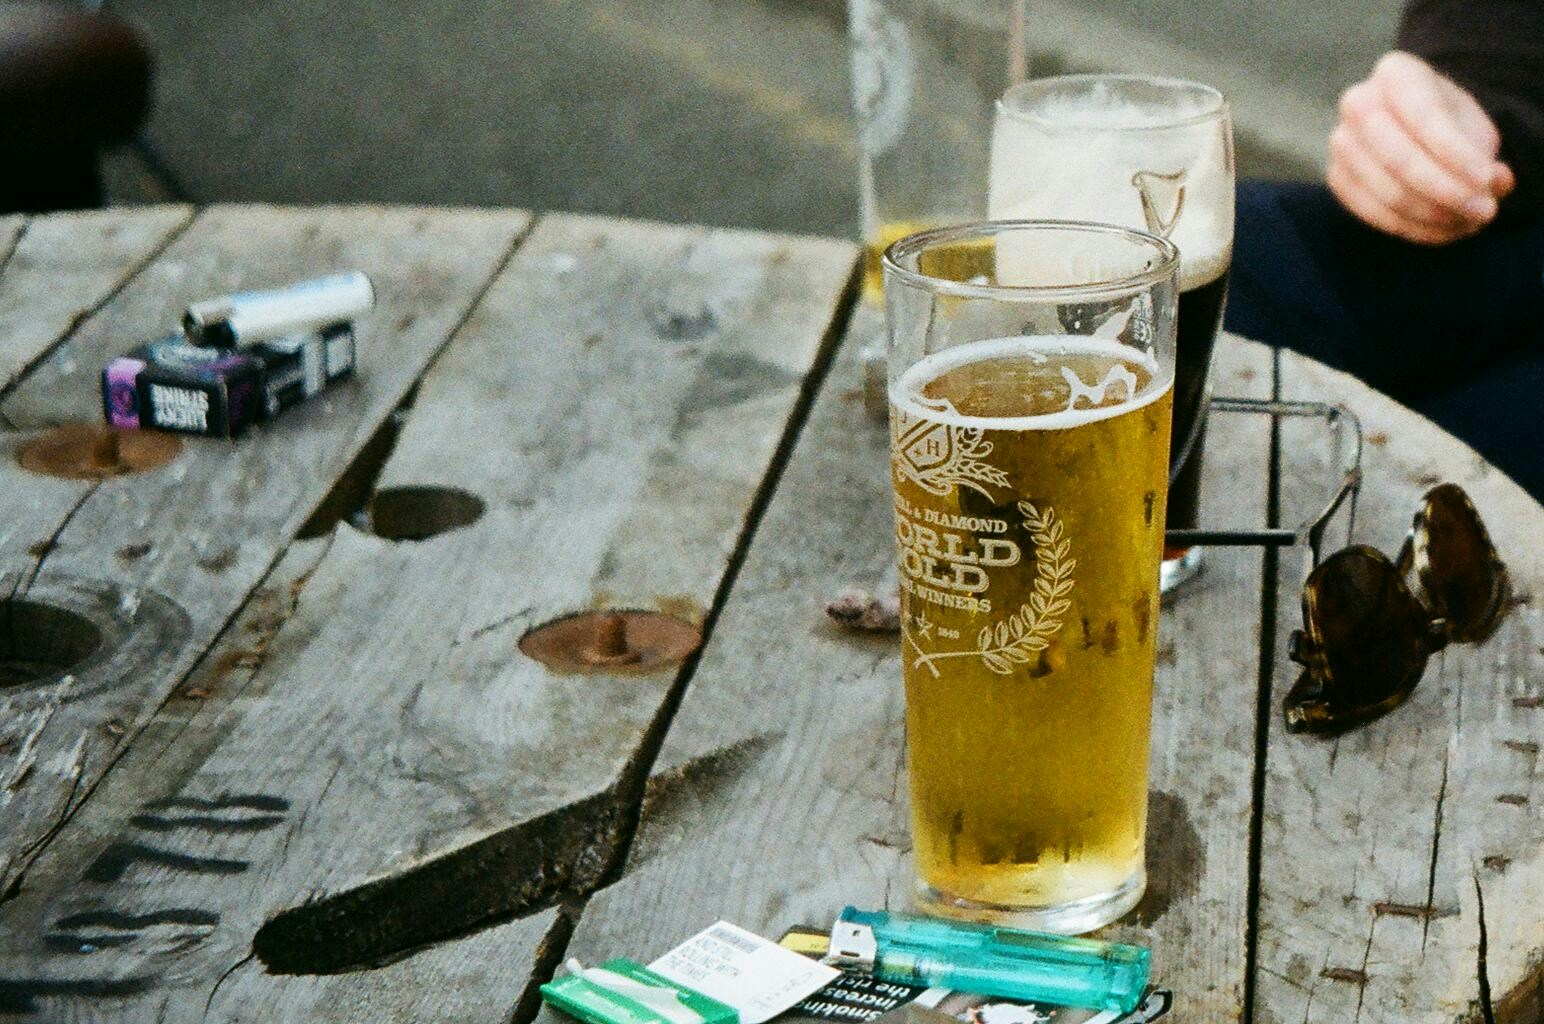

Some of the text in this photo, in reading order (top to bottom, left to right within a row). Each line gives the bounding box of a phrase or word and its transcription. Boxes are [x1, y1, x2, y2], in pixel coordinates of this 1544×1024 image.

[924, 509, 1008, 534] DIAMOND
[896, 515, 1021, 568] ORLD
[900, 545, 990, 594] OLD
[916, 584, 992, 614] WINNERS
[822, 987, 897, 1011] increas
[875, 983, 911, 998] the
